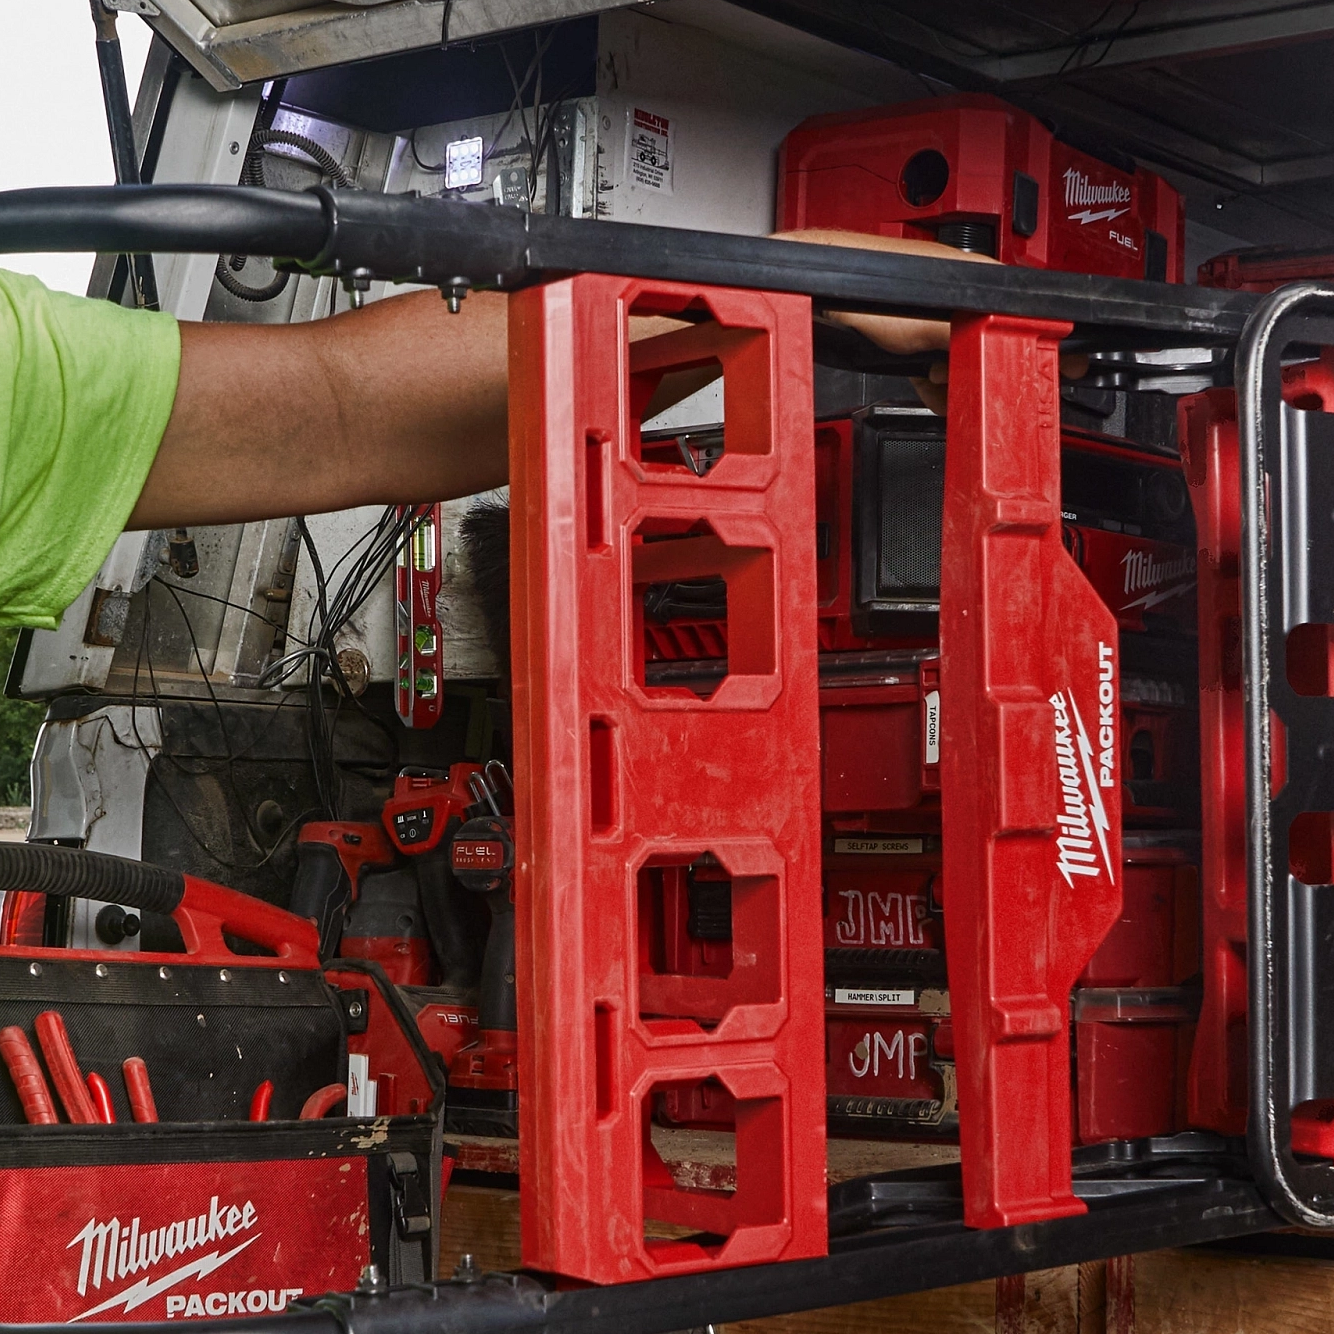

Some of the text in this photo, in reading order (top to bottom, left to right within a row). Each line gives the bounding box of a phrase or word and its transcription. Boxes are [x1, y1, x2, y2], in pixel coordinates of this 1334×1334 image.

[1063, 167, 1131, 208] Milwaukee
[1109, 230, 1138, 251] FUEL
[1119, 549, 1196, 594] Milwauke
[928, 705, 937, 746] TAPCONS
[1099, 642, 1114, 788] PACKOUT
[1048, 691, 1101, 889] Milwaukee
[455, 846, 496, 856] FUEL
[847, 842, 909, 851] SELFTAP SCREWS
[436, 1012, 479, 1025] FUEL
[849, 1029, 928, 1081] JMP
[66, 1195, 259, 1298] Milwaukee
[166, 1287, 304, 1319] PACKOUT
